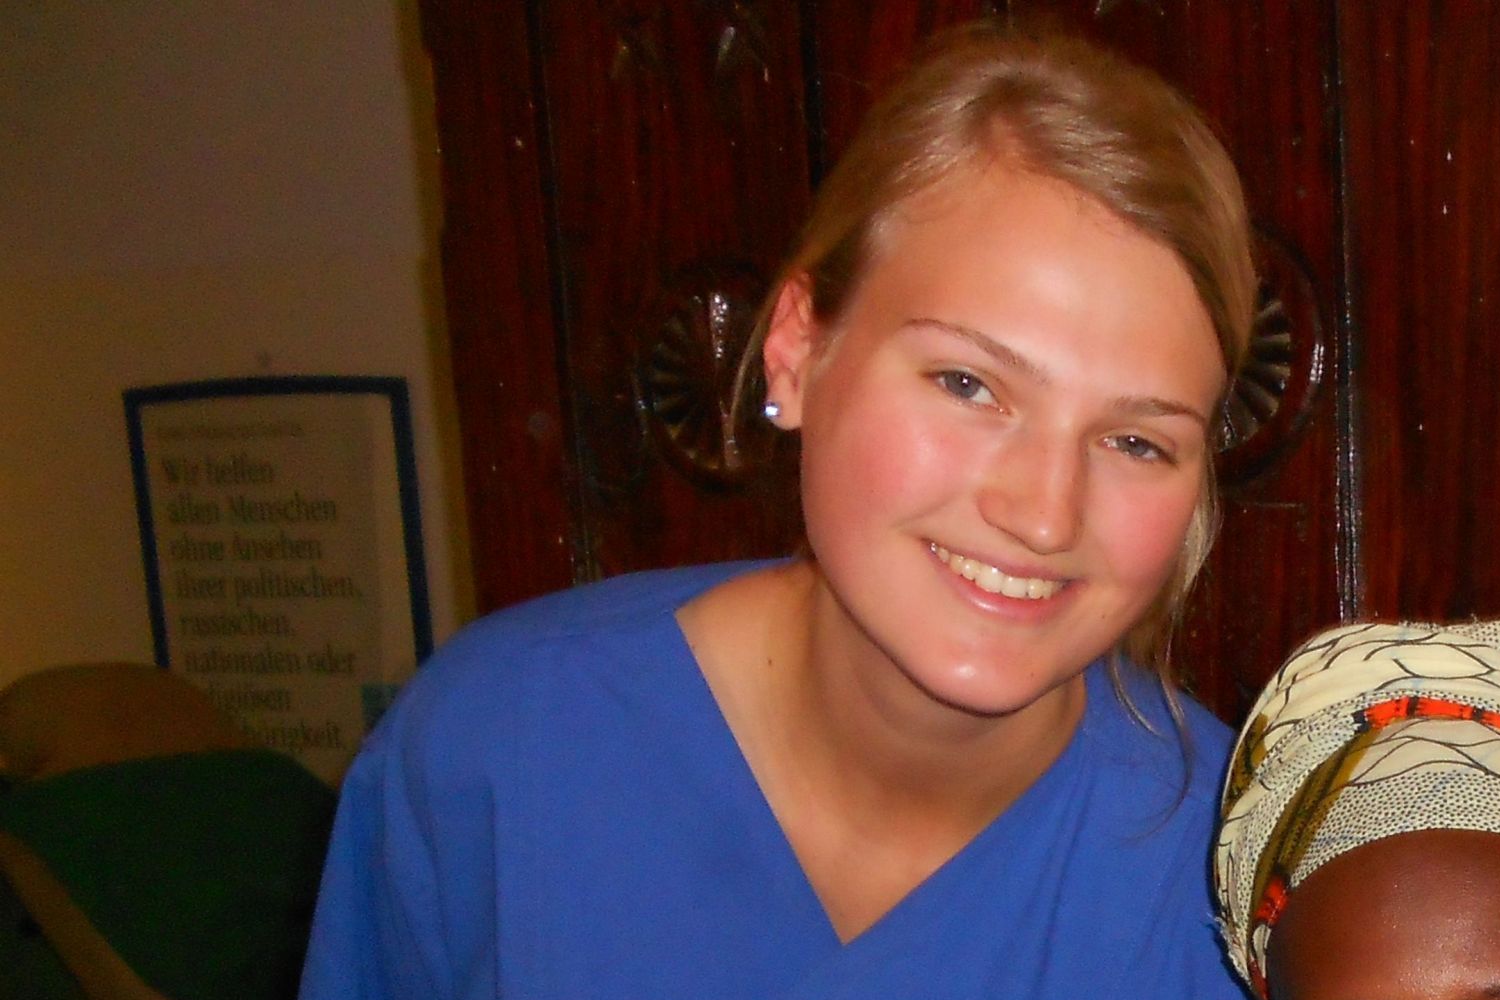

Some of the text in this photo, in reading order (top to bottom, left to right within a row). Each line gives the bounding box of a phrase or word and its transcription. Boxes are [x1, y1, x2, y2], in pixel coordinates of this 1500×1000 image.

[161, 451, 275, 485] Wir helfen
[169, 491, 337, 525] allen Menschen
[171, 531, 322, 562] ohne Ansehen
[176, 566, 364, 606] ihrer politischen,
[185, 639, 357, 674] nationalen oder
